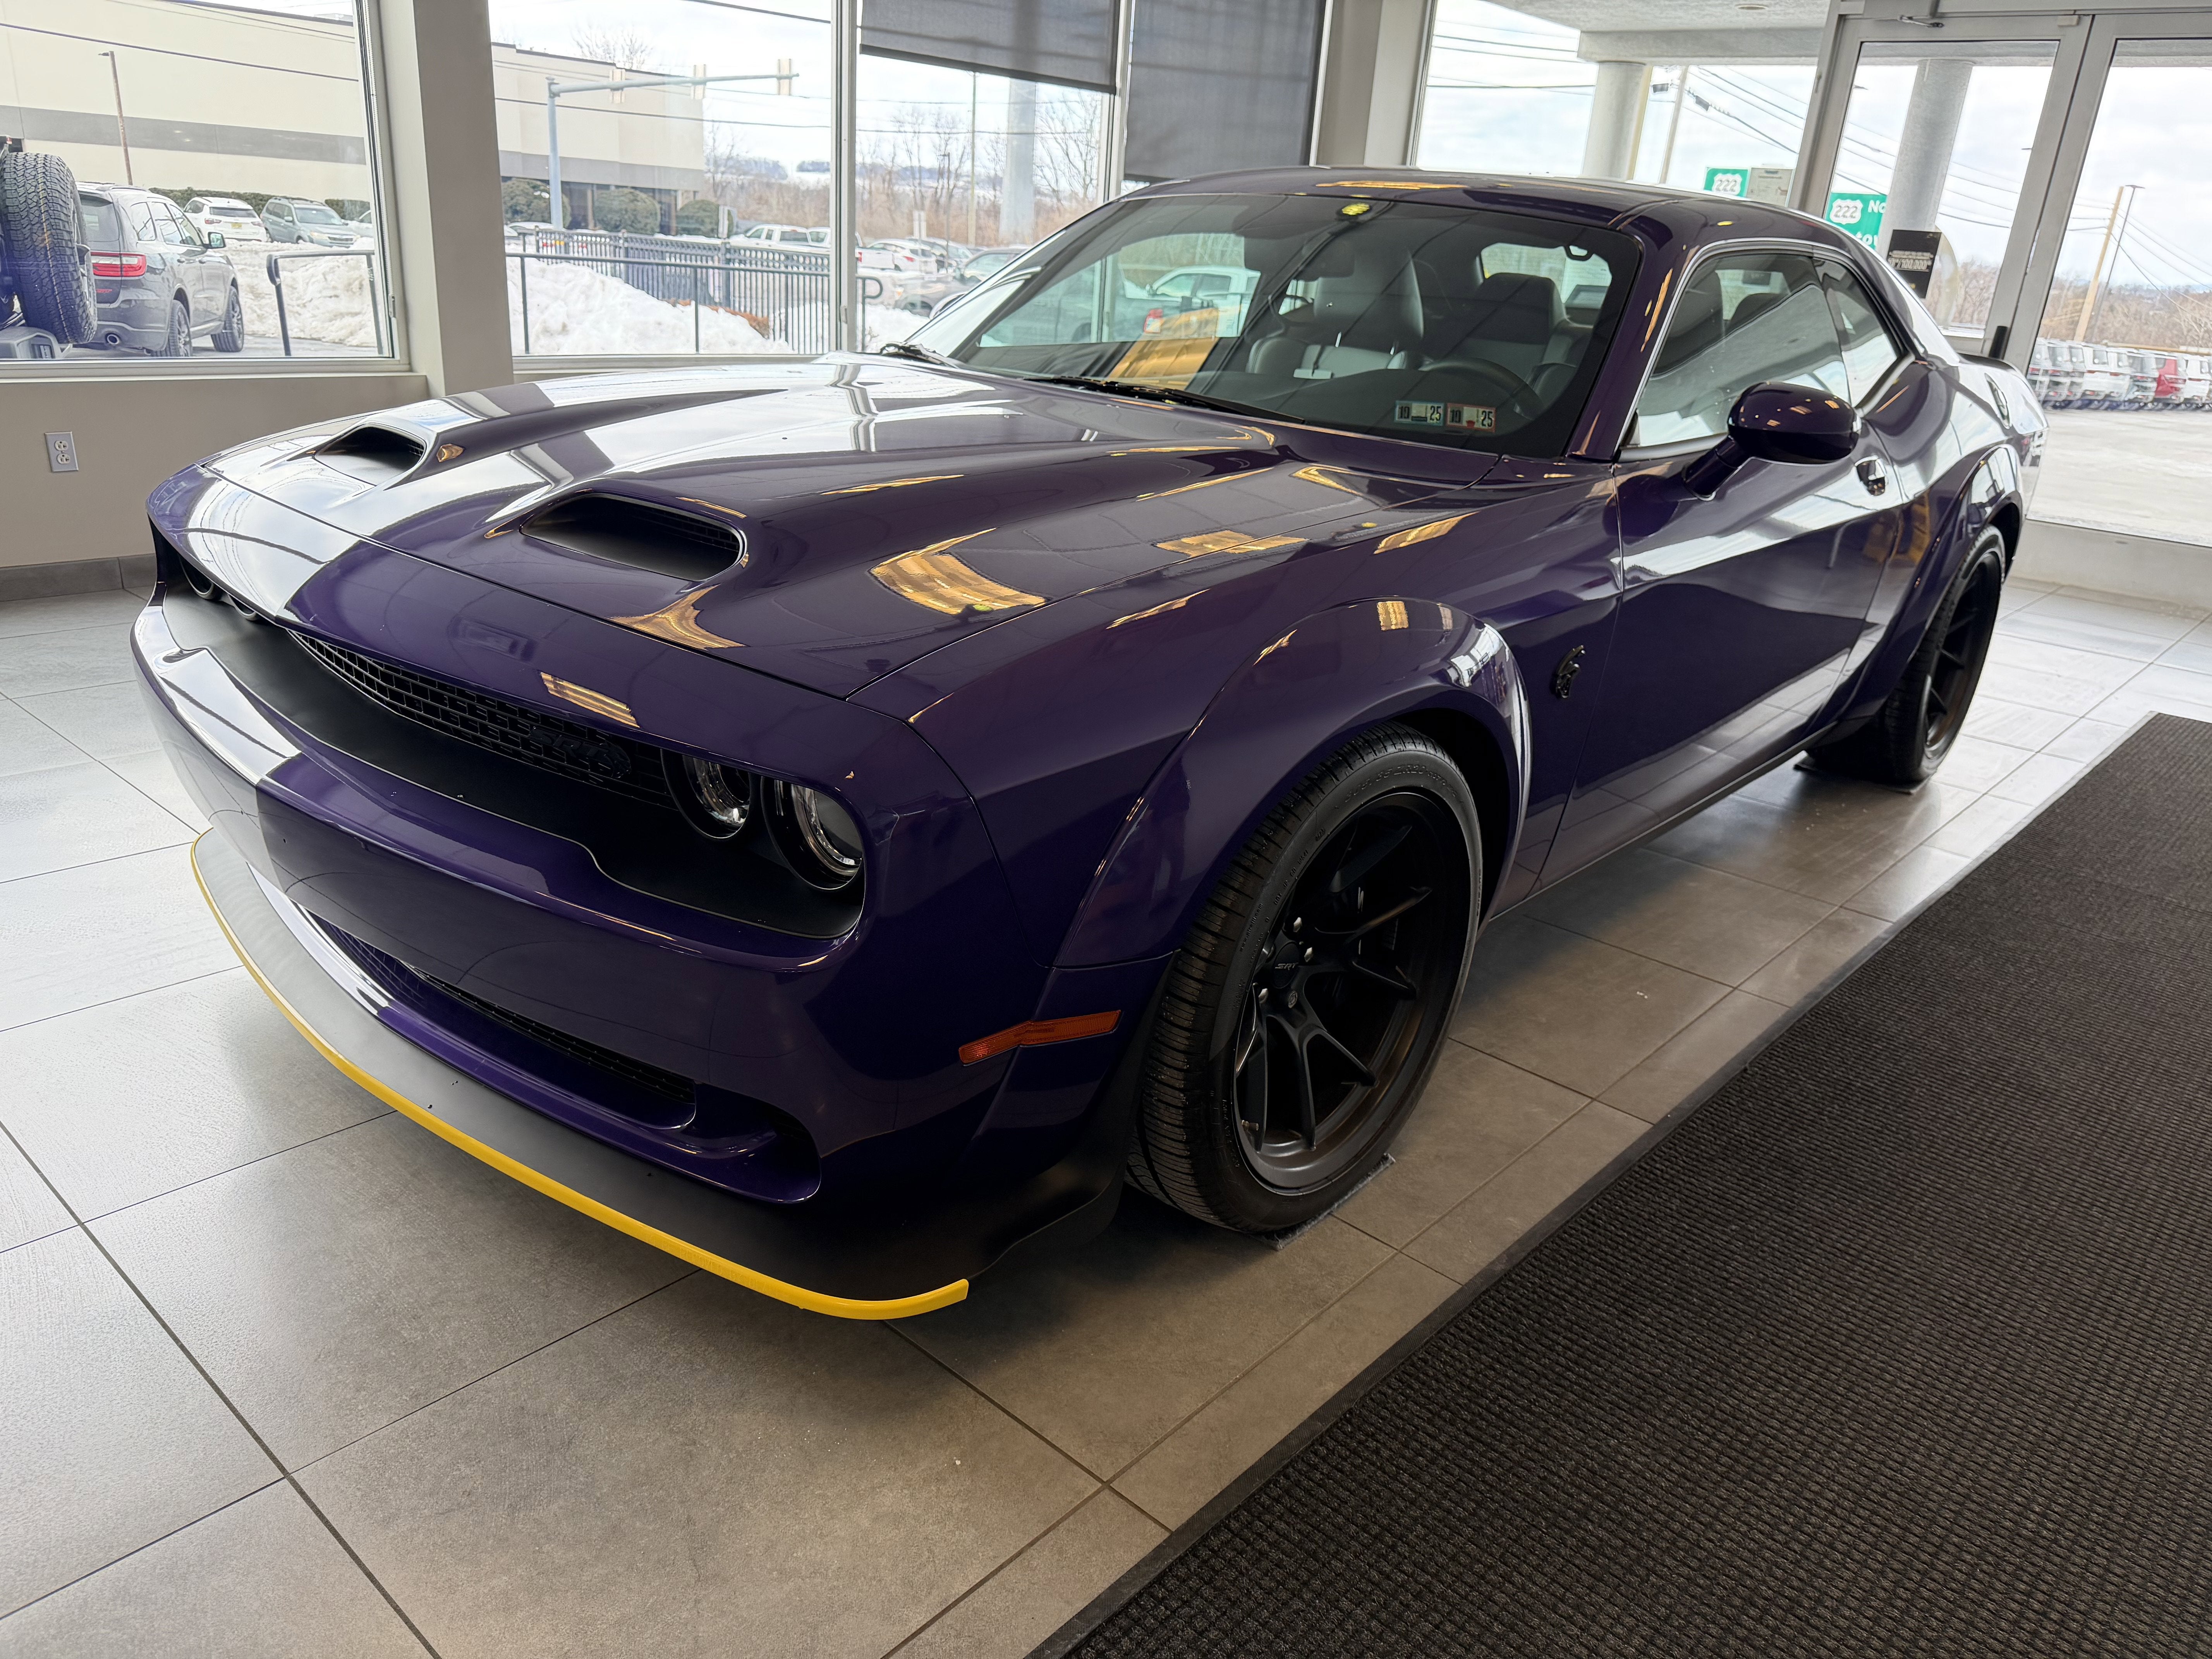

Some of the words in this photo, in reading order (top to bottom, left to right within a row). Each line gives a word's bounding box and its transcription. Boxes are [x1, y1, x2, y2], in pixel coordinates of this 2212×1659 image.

[1716, 179, 1737, 192] 222
[1834, 205, 1857, 218] 222
[1399, 406, 1410, 419] 10
[1430, 405, 1441, 421] 25
[1450, 409, 1461, 423] 10
[1482, 410, 1493, 427] 25
[529, 726, 610, 758] SRT
[1274, 962, 1299, 971] SRT
